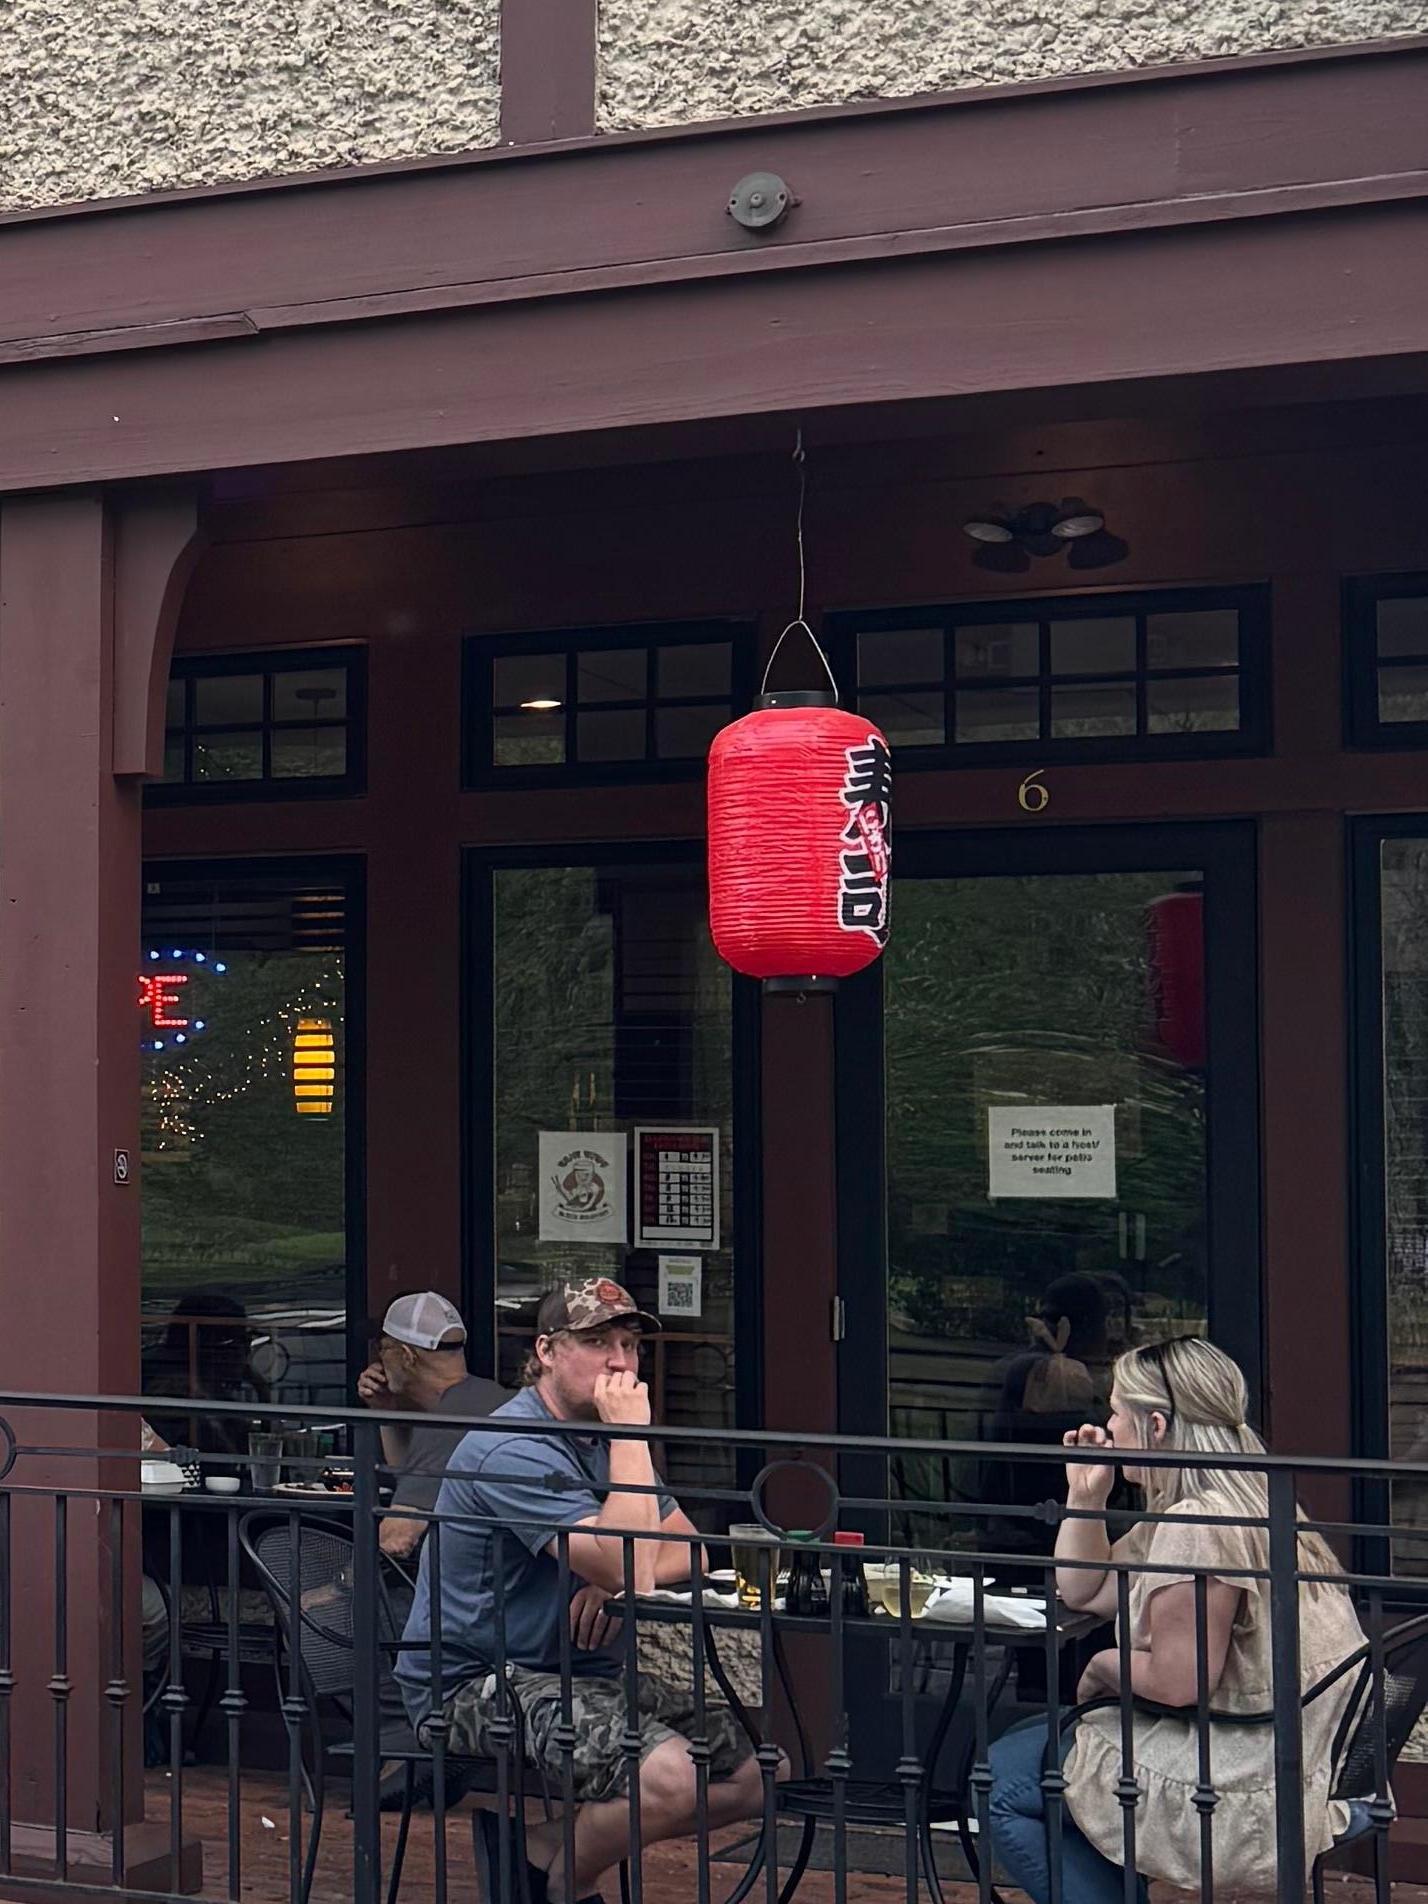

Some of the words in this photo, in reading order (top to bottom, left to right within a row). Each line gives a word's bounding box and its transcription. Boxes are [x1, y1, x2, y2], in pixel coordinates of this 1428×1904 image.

[1018, 769, 1049, 812] 6
[1011, 1127, 1046, 1137] Please
[1049, 1128, 1080, 1137] come
[1082, 1127, 1093, 1136] in
[1004, 1140, 1023, 1149] and
[1026, 1140, 1046, 1149] talk
[1049, 1140, 1060, 1149] to
[1011, 1154, 1045, 1162] server
[1047, 1152, 1063, 1162] for
[1032, 1165, 1072, 1175] seating
